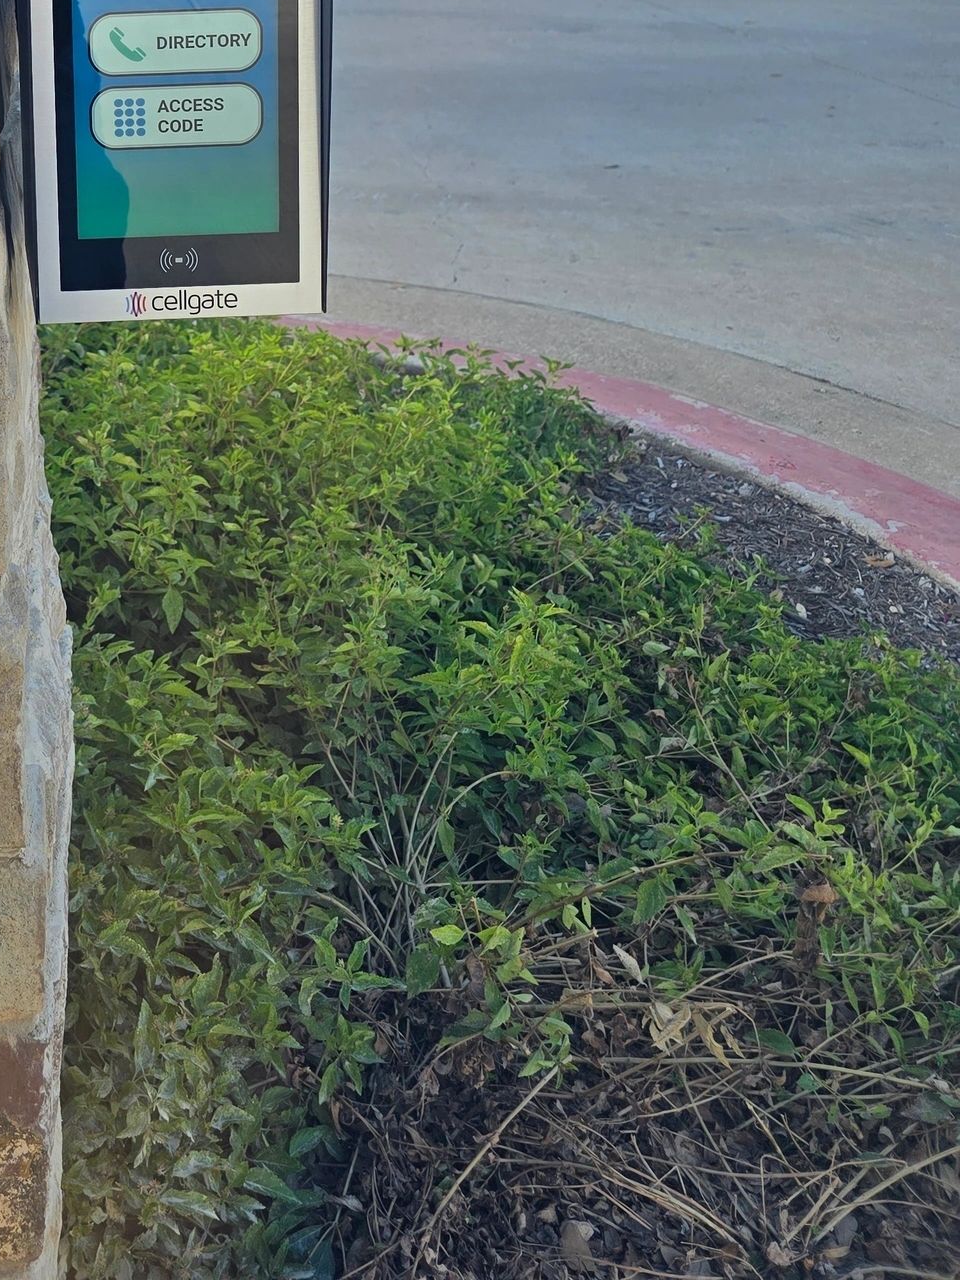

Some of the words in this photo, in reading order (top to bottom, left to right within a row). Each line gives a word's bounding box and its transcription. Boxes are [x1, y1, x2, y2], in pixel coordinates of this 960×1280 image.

[156, 32, 252, 50] DIRECTORY
[157, 97, 225, 113] ACCESS
[157, 118, 204, 133] CODE
[151, 289, 239, 315] cellgate
